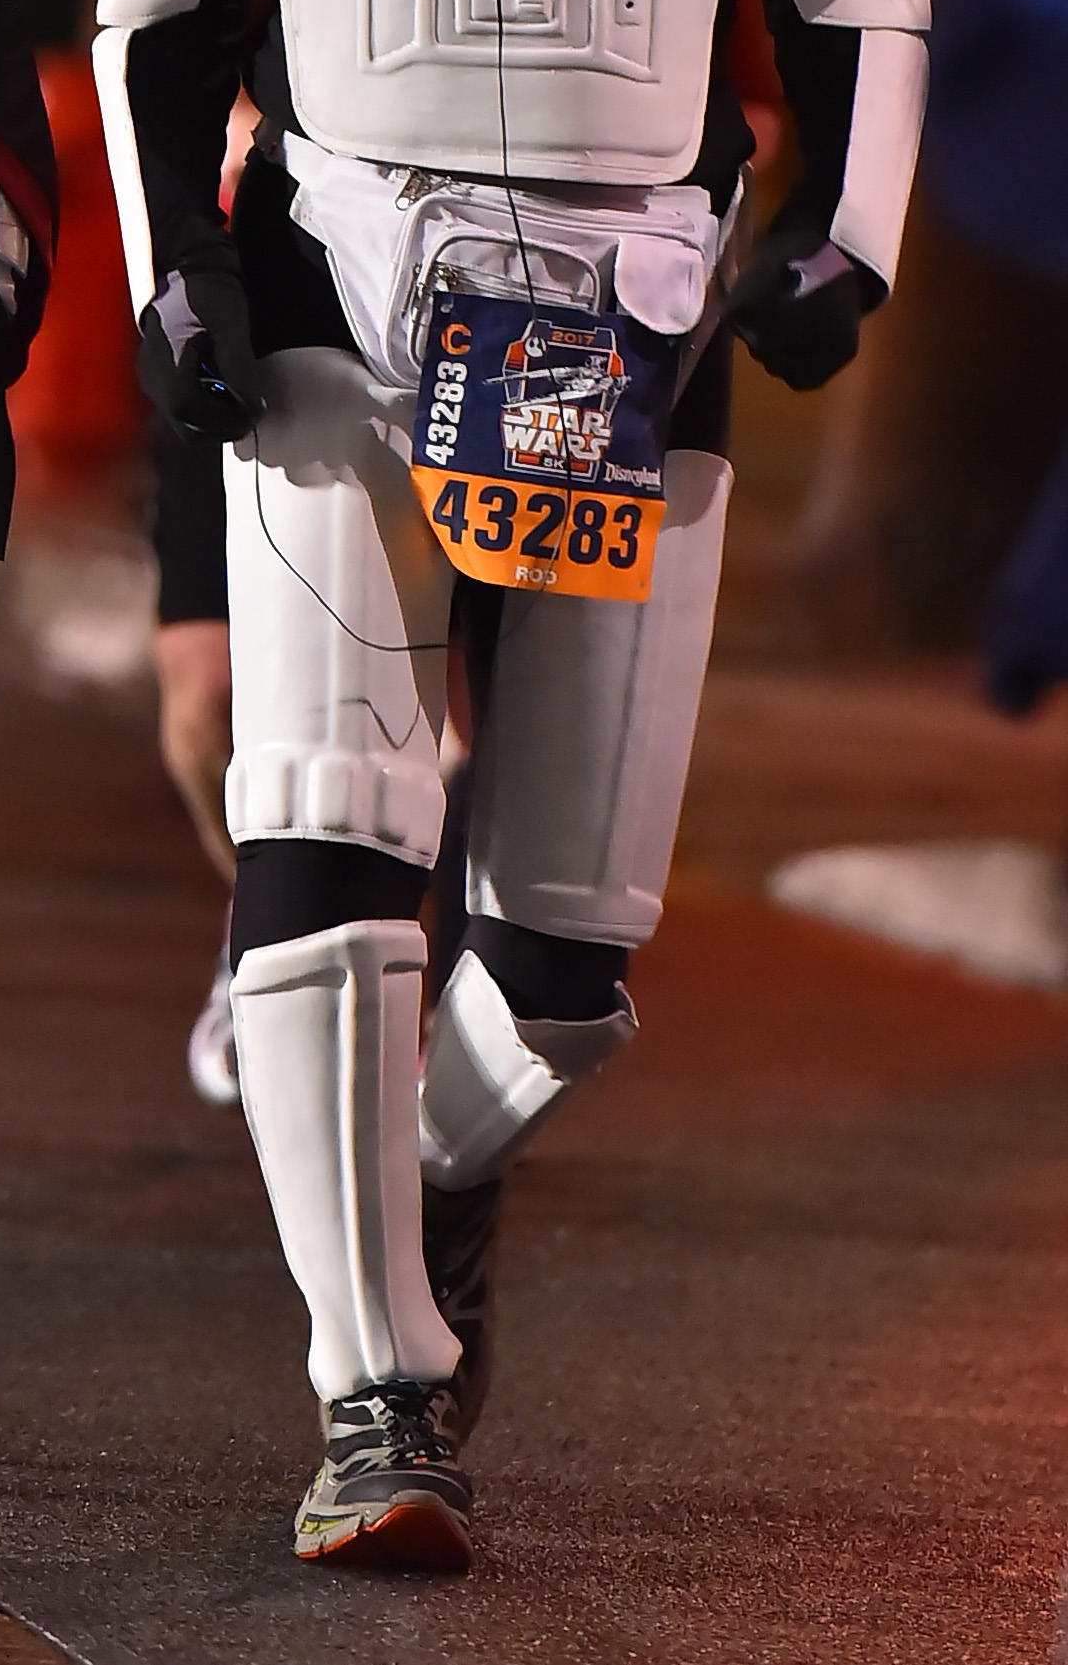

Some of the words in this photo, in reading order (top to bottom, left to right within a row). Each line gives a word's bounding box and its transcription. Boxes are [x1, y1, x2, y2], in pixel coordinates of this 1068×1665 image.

[441, 324, 472, 355] C
[551, 331, 595, 346] 2017
[425, 361, 468, 465] 43283
[503, 404, 611, 438] STAR
[503, 423, 609, 461] WARS
[543, 457, 565, 469] 5K
[603, 461, 662, 487] Disneyland
[432, 480, 642, 569] 43283
